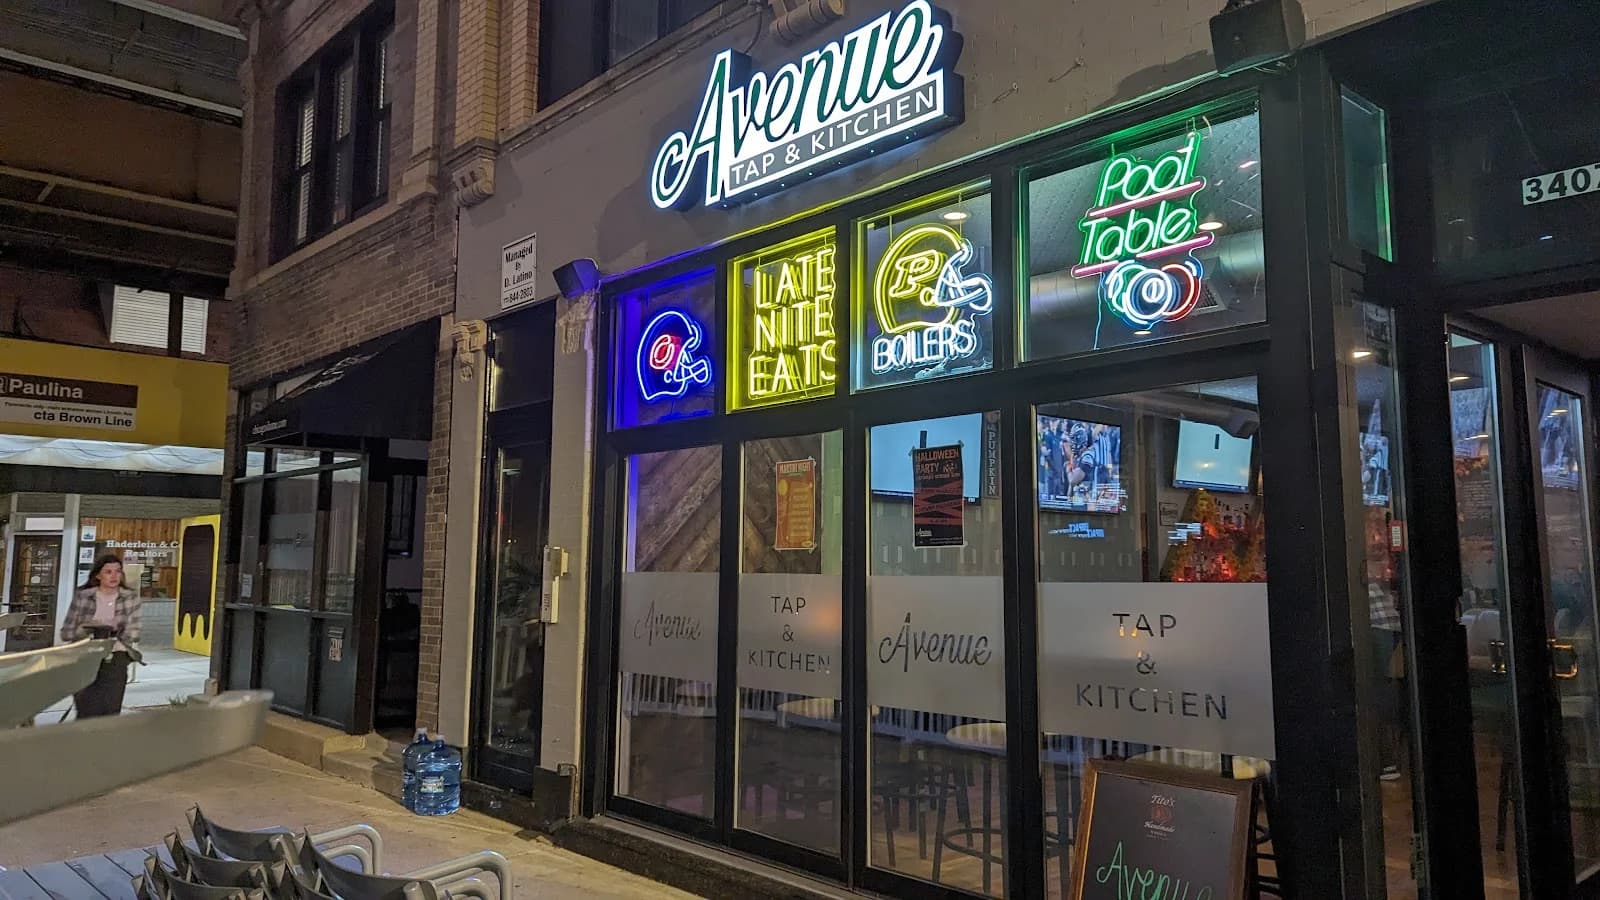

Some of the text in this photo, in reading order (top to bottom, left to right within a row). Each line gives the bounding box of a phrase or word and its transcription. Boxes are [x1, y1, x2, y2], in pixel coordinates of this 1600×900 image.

[652, 1, 943, 208] Avenue
[731, 85, 935, 186] TAP & KITCHEN
[1083, 201, 1191, 264] Table
[505, 242, 533, 263] Managed
[513, 271, 533, 285] Latino
[755, 249, 833, 308] LATE
[755, 294, 831, 351] NITE
[873, 319, 974, 371] BOILERS
[9, 378, 84, 399] Paulina
[34, 410, 133, 427] cta Brown Line
[915, 448, 959, 462] HALLOWEEN
[987, 431, 997, 495] PUMPKIN
[106, 540, 157, 548] Haderlein
[124, 549, 168, 558] Realtors
[771, 595, 806, 614] TAP
[633, 600, 701, 647] Avenue
[782, 624, 795, 642] &
[1112, 613, 1177, 637] TAP
[878, 612, 992, 672] Avenue
[749, 650, 831, 673] KITCHEN
[1135, 650, 1158, 675] &
[1075, 683, 1227, 720] KITCHEN
